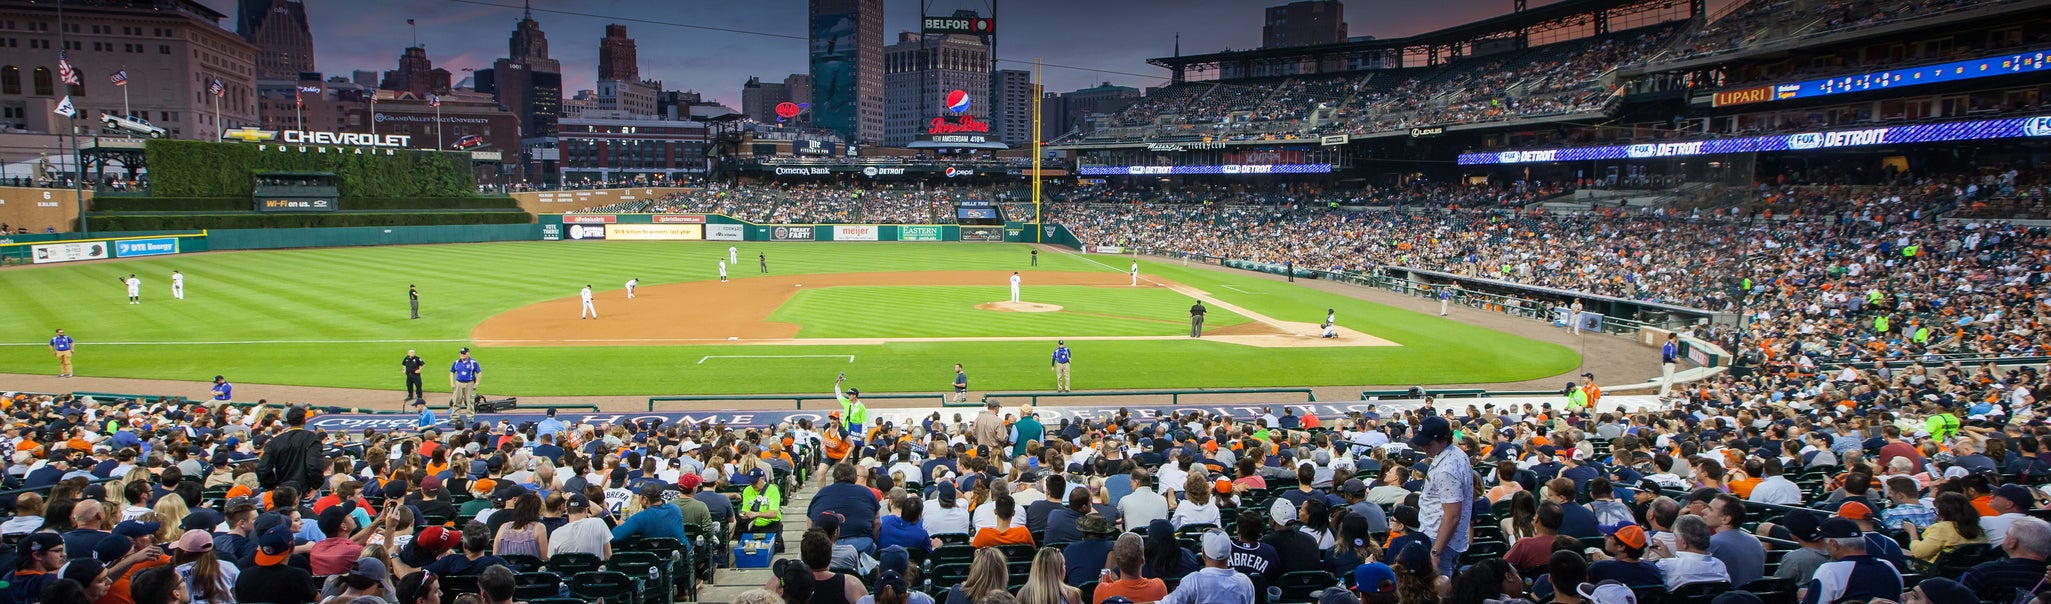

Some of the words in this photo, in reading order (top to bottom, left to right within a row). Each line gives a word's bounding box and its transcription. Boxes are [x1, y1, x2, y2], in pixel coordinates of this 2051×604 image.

[925, 19, 969, 30] BELFOR
[1864, 74, 1871, 82] 7
[2013, 55, 2021, 63] 7
[1719, 88, 1766, 106] LIPARI
[1419, 128, 1443, 136] LEXUS
[1796, 134, 1815, 144] FOX
[1824, 128, 1889, 147] DETROIT
[284, 130, 411, 147] CHEVROLET
[259, 144, 395, 156] FOUNTAIN
[1657, 142, 1703, 156] DETROIT
[1520, 150, 1556, 162] DETROIT
[811, 166, 830, 175] Bank
[1145, 166, 1173, 174] DETROIT
[1241, 165, 1273, 173] DETROIT
[266, 200, 287, 208] Wi-Fi
[299, 200, 310, 208] us.
[842, 226, 869, 237] meijer
[903, 225, 937, 234] EASTERN
[1227, 552, 1269, 574] ABRERA
